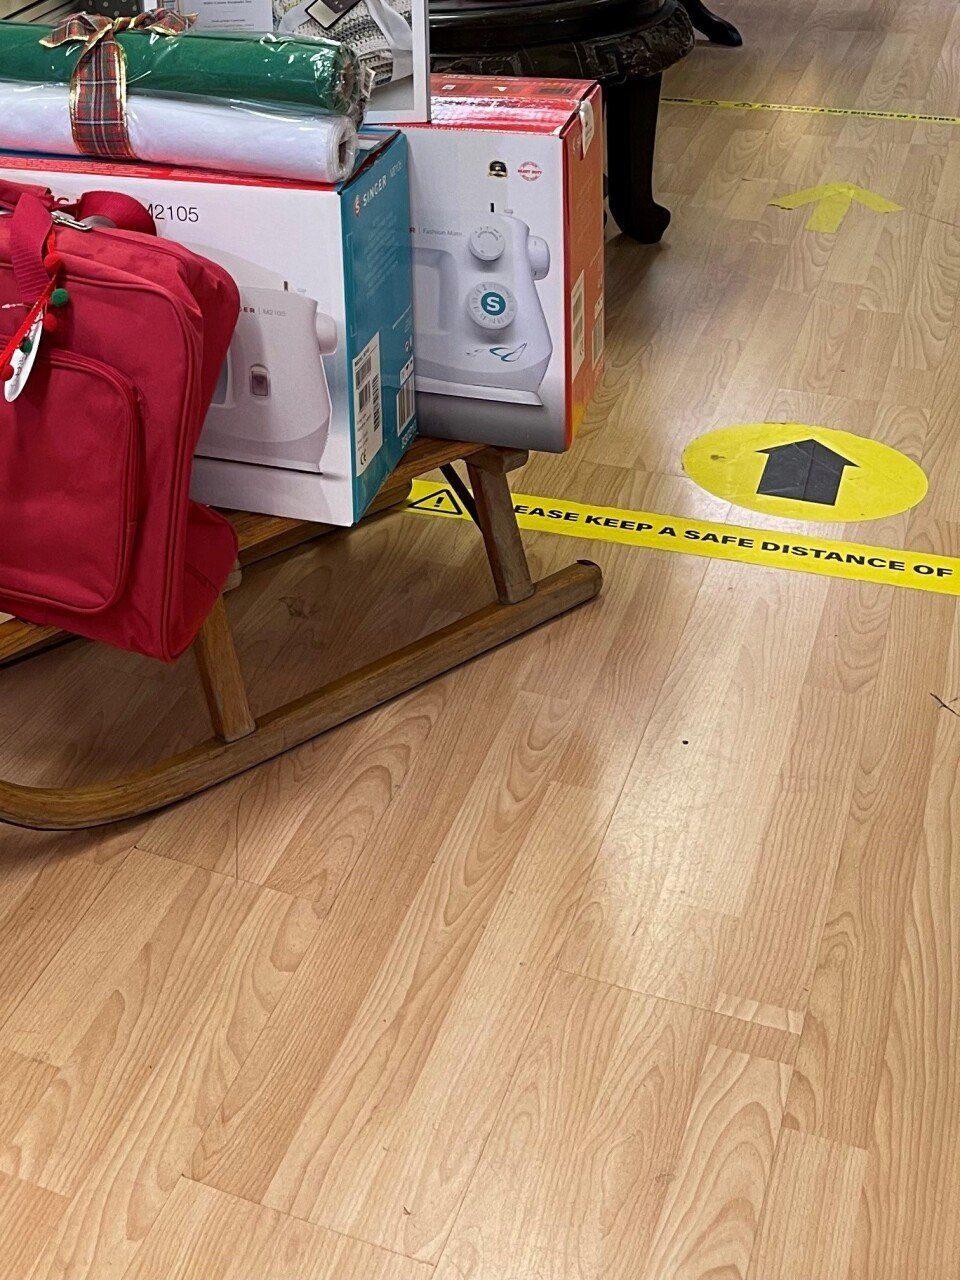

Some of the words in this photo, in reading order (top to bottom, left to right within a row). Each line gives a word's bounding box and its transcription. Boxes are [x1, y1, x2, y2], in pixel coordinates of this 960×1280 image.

[363, 176, 388, 207] SINGER
[423, 228, 447, 236] Fashion
[515, 504, 580, 523] EASE
[586, 516, 654, 533] KEEP
[659, 527, 677, 537] A
[684, 530, 755, 549] SAFE
[761, 542, 907, 571] DISTANCE
[913, 565, 954, 578] OF
